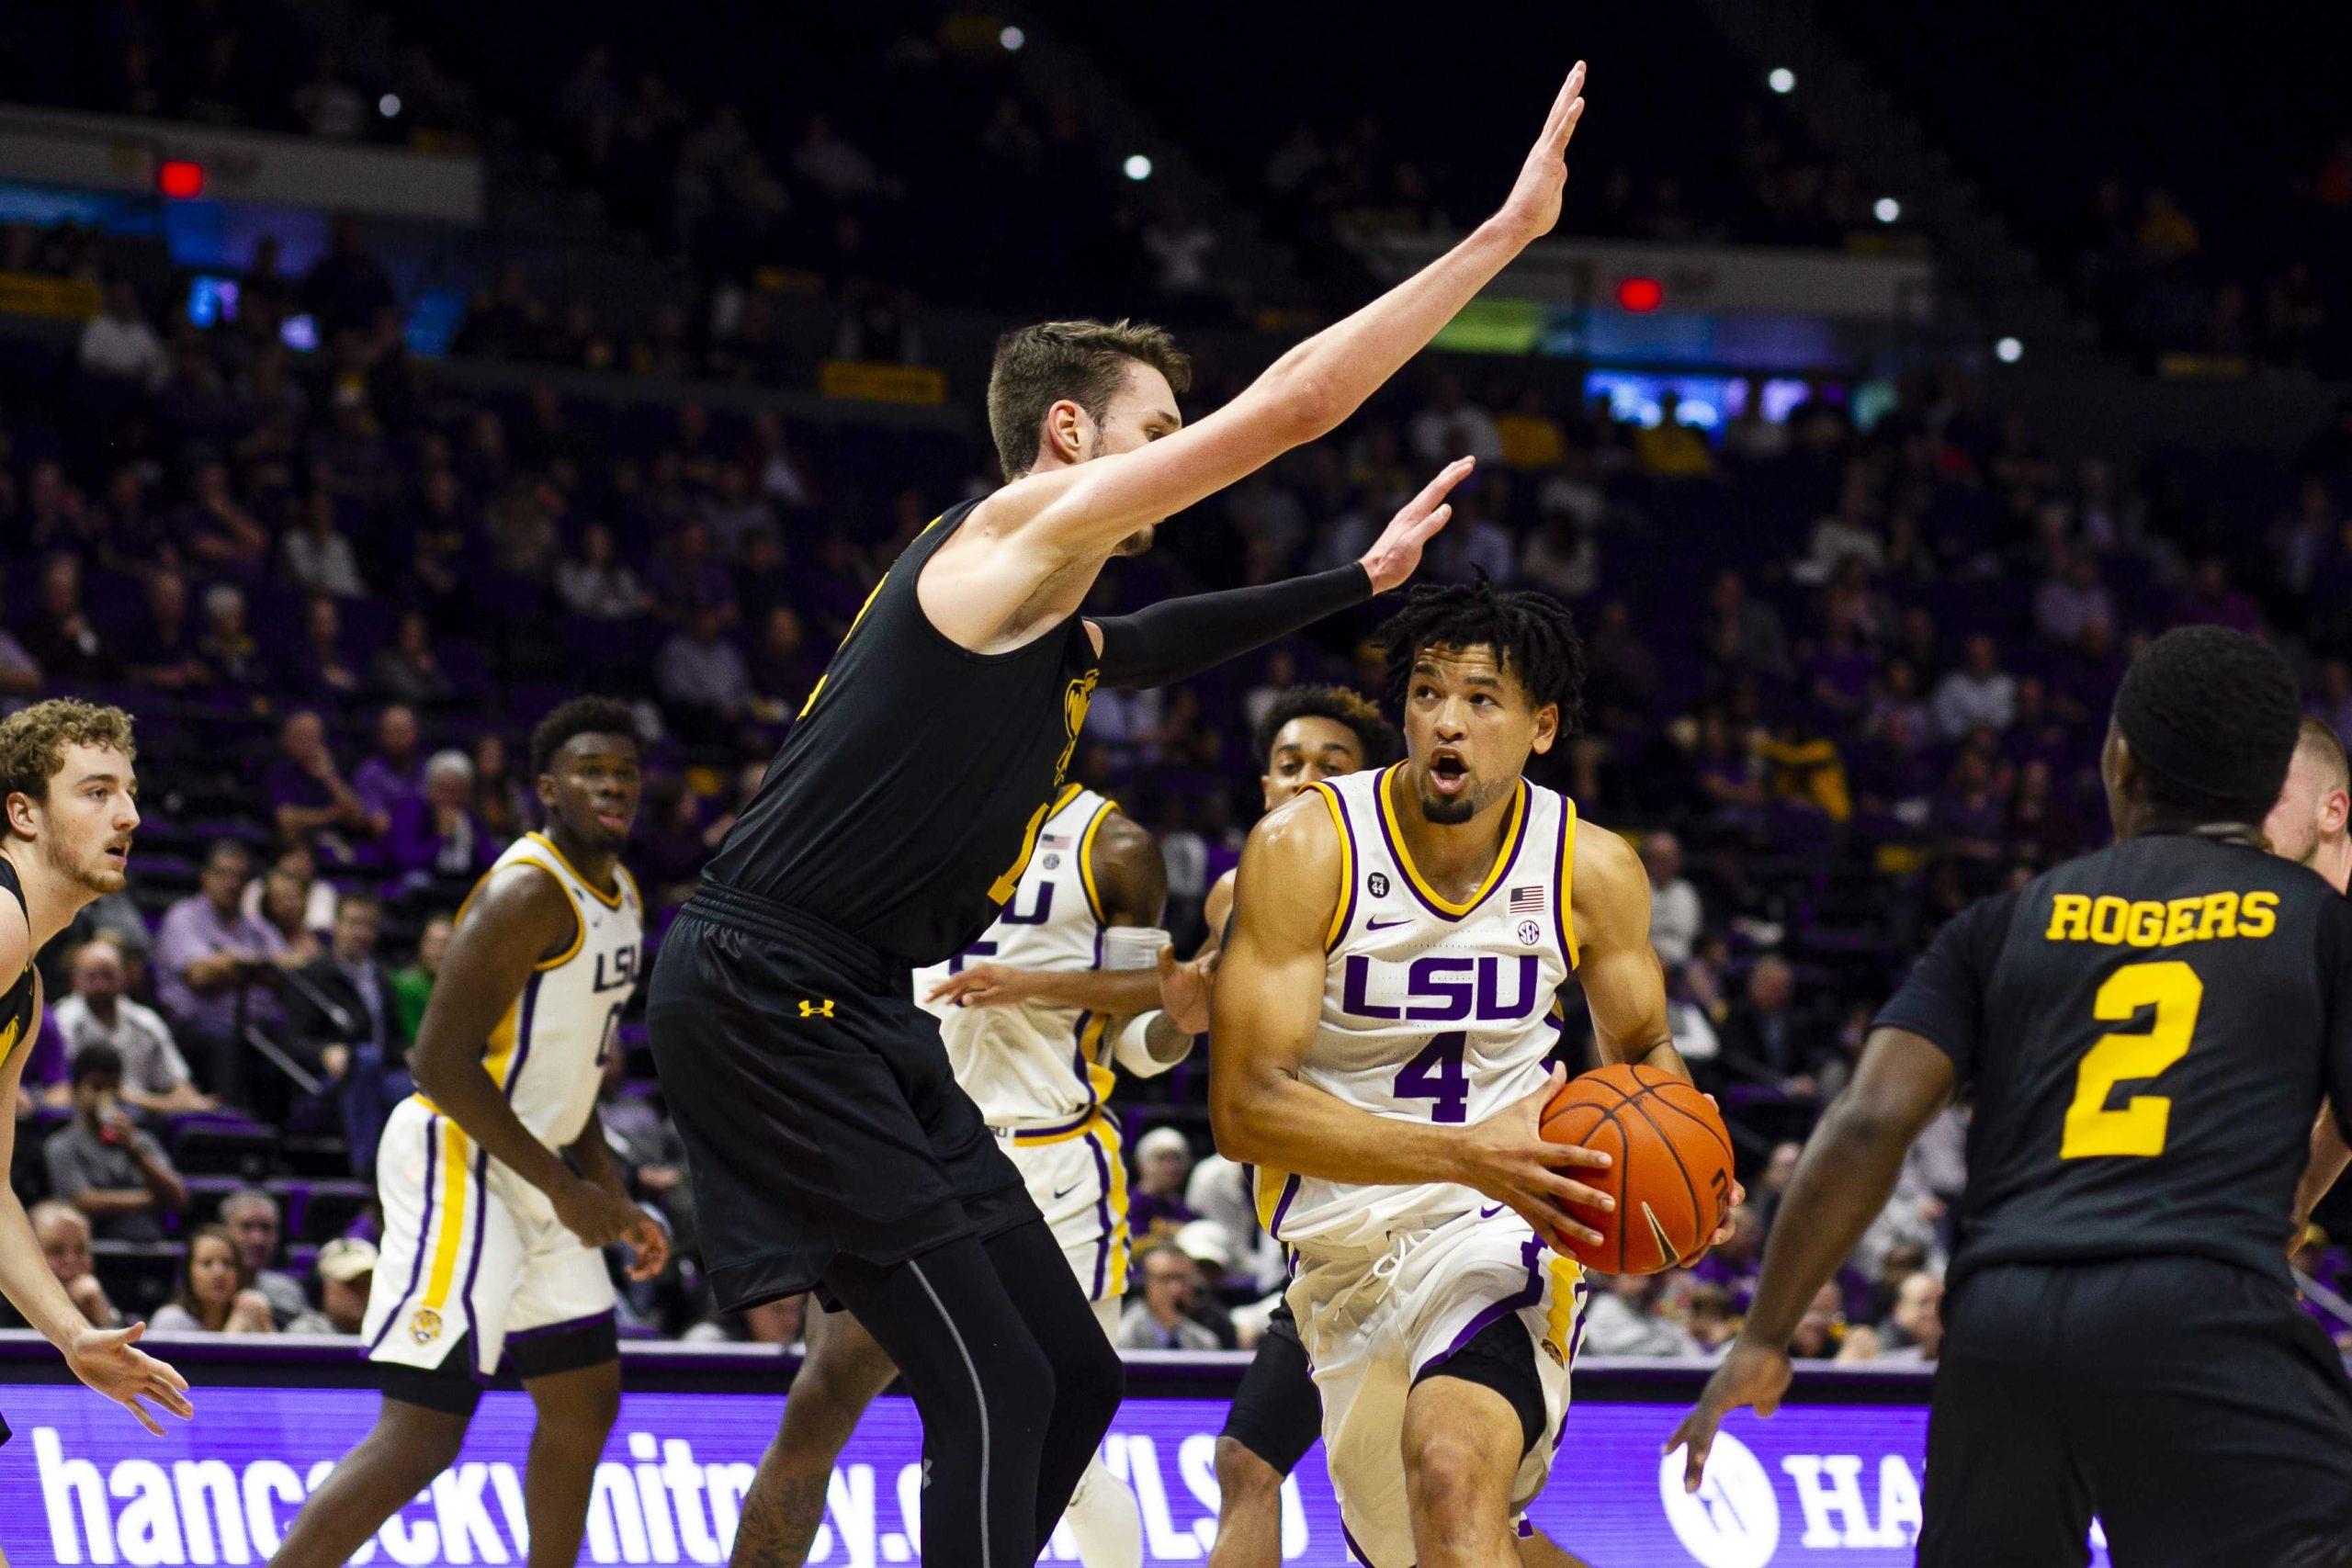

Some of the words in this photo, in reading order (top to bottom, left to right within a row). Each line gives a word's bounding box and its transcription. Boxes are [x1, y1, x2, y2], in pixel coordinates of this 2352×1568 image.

[1372, 882, 1385, 896] 44
[2045, 891, 2280, 947] ROGERS
[1518, 920, 1540, 945] SEC
[1342, 954, 1539, 1021] LSU
[1393, 1031, 1470, 1122] 4
[2060, 960, 2204, 1160] 2
